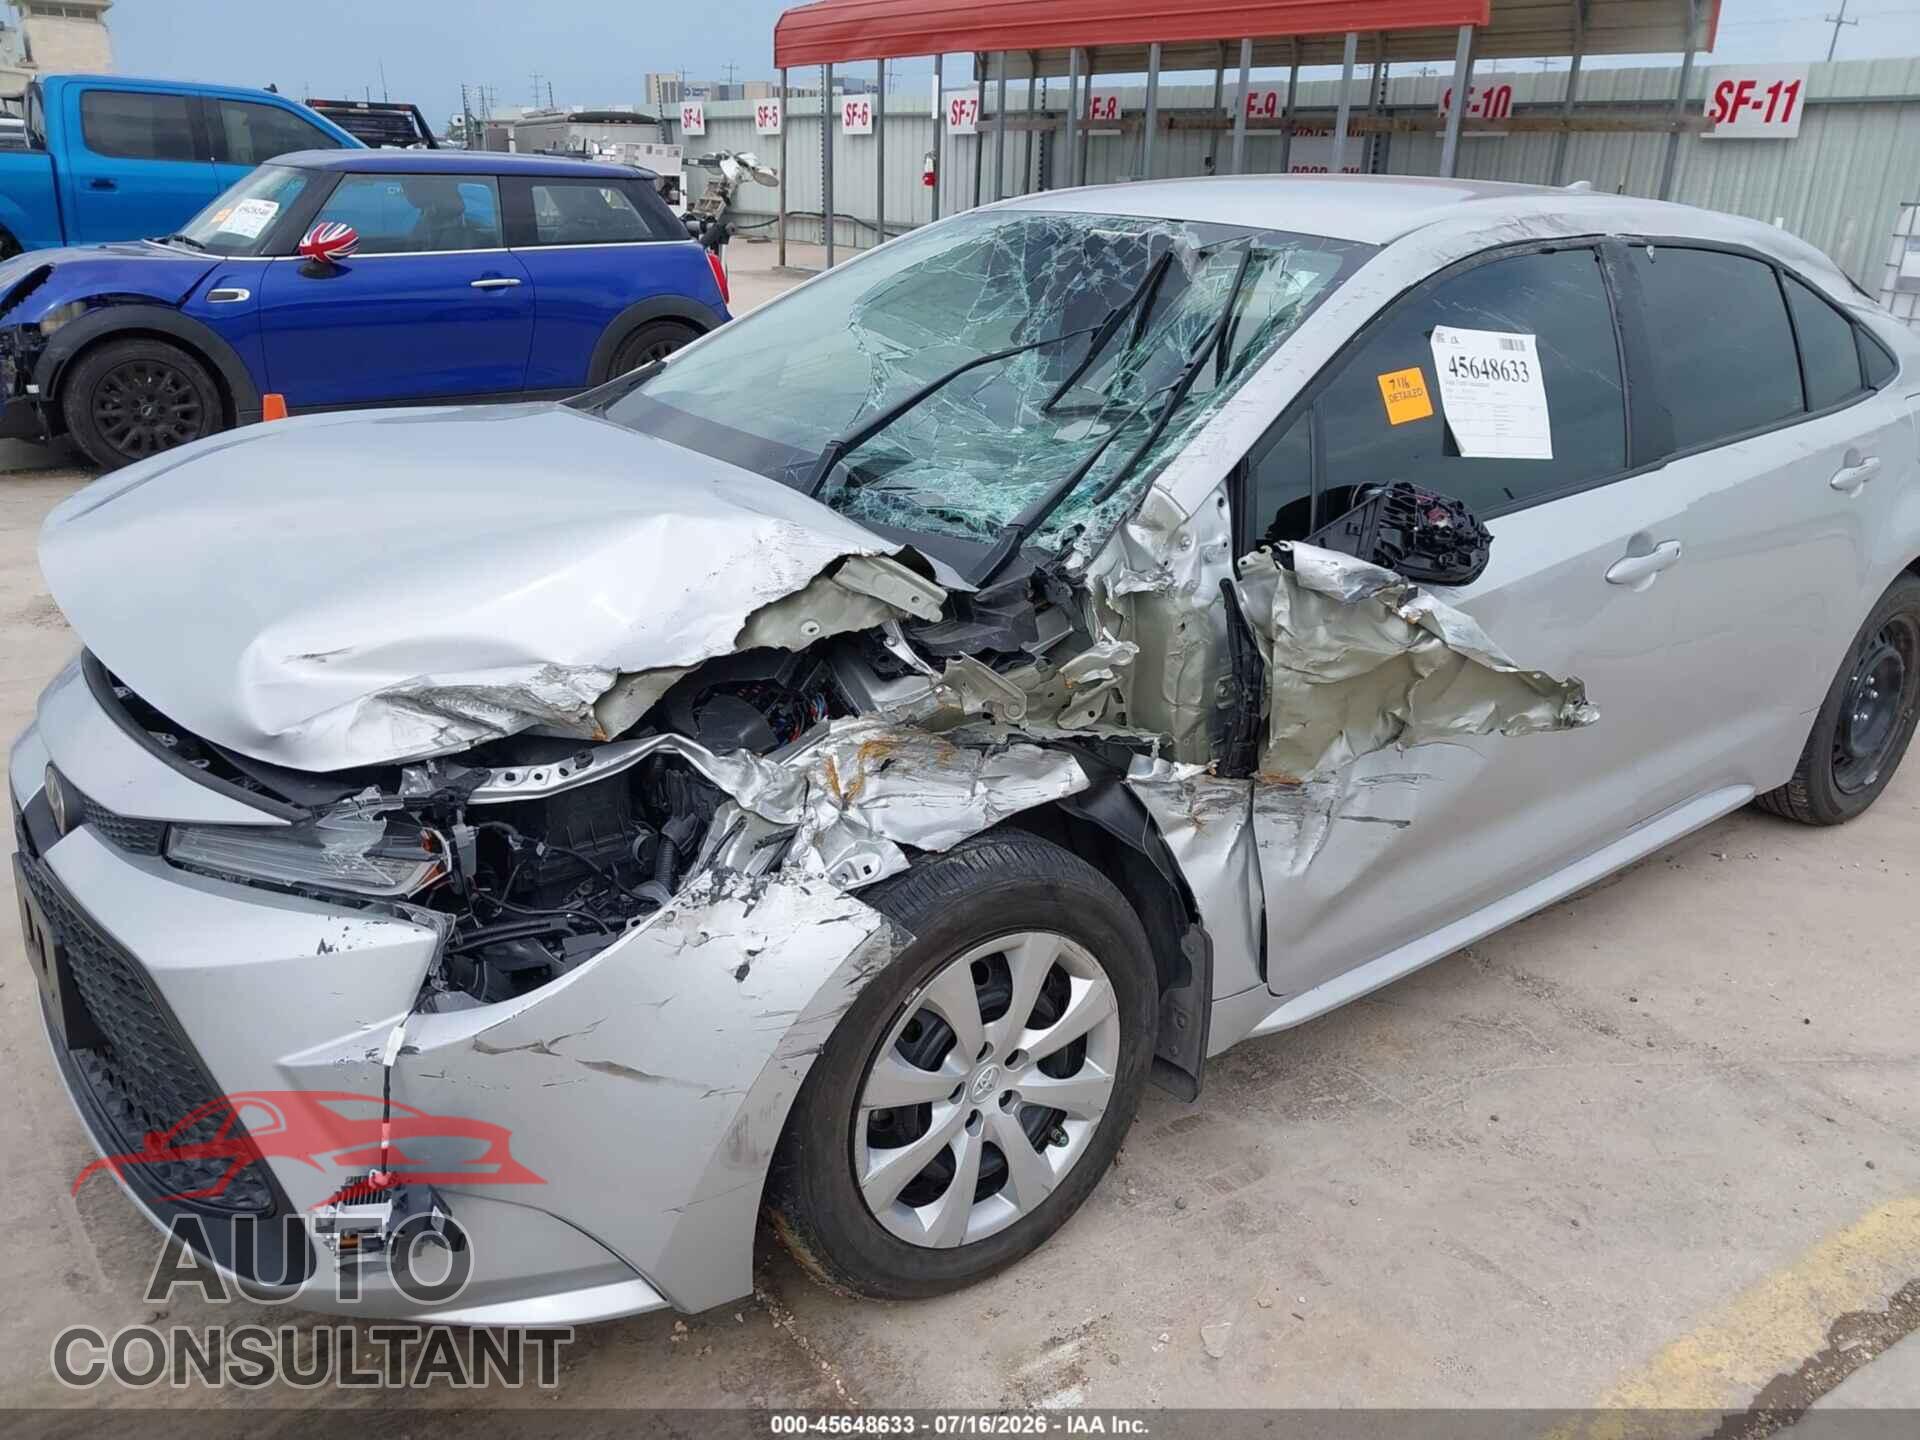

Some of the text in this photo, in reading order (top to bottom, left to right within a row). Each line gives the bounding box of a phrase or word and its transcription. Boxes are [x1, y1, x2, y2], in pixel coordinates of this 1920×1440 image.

[950, 99, 978, 126] SF-7
[1091, 95, 1117, 120] F-8
[1245, 92, 1277, 118] F-9
[1708, 79, 1802, 124] SF-11
[683, 107, 702, 130] SF-4
[757, 105, 779, 128] SF-5
[844, 102, 869, 127] SF-6
[1448, 354, 1530, 383] 45648633
